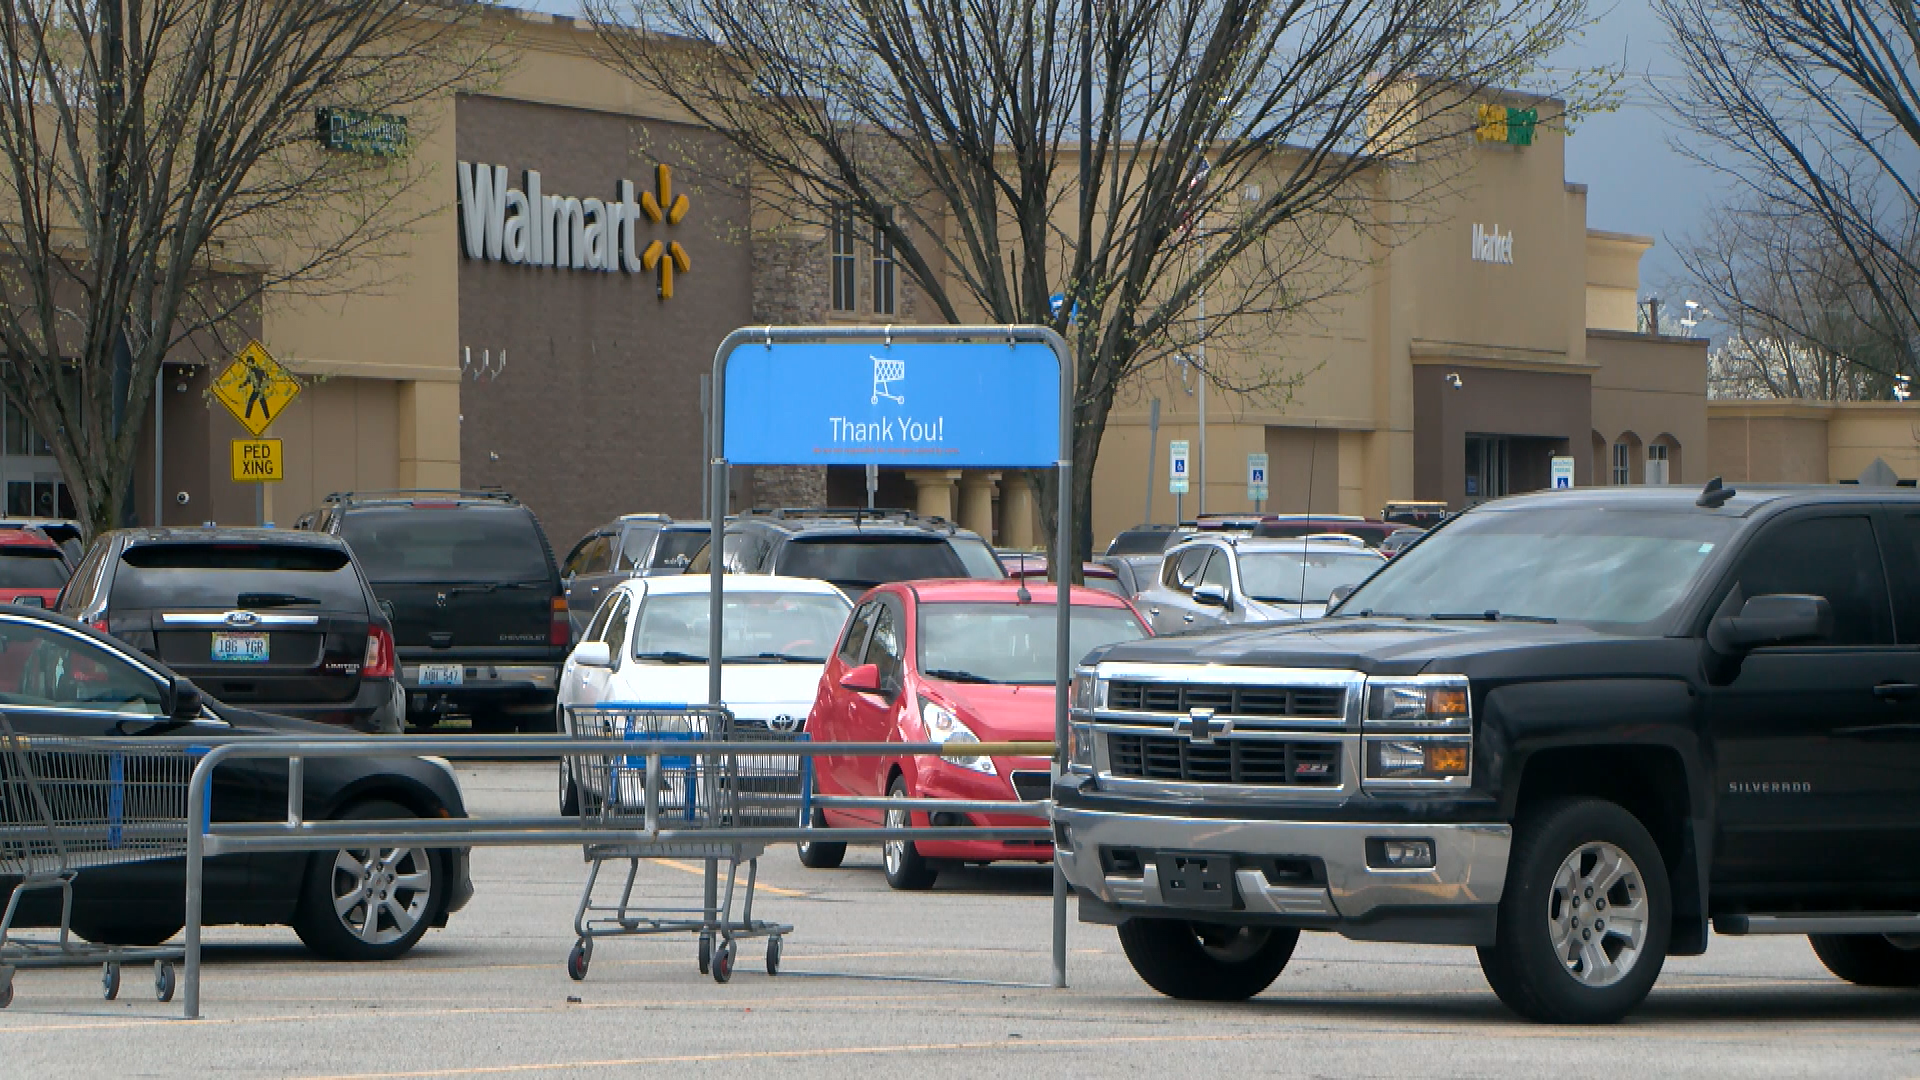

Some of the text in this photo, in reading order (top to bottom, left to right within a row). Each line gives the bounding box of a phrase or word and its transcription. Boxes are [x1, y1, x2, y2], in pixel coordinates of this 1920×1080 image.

[457, 160, 641, 273] Walmart
[1472, 222, 1514, 265] Market
[829, 416, 944, 442] Thank You!
[243, 444, 271, 459] PED
[242, 460, 274, 475] XING
[245, 639, 264, 654] YGR
[1729, 781, 1812, 793] SILVERADO
